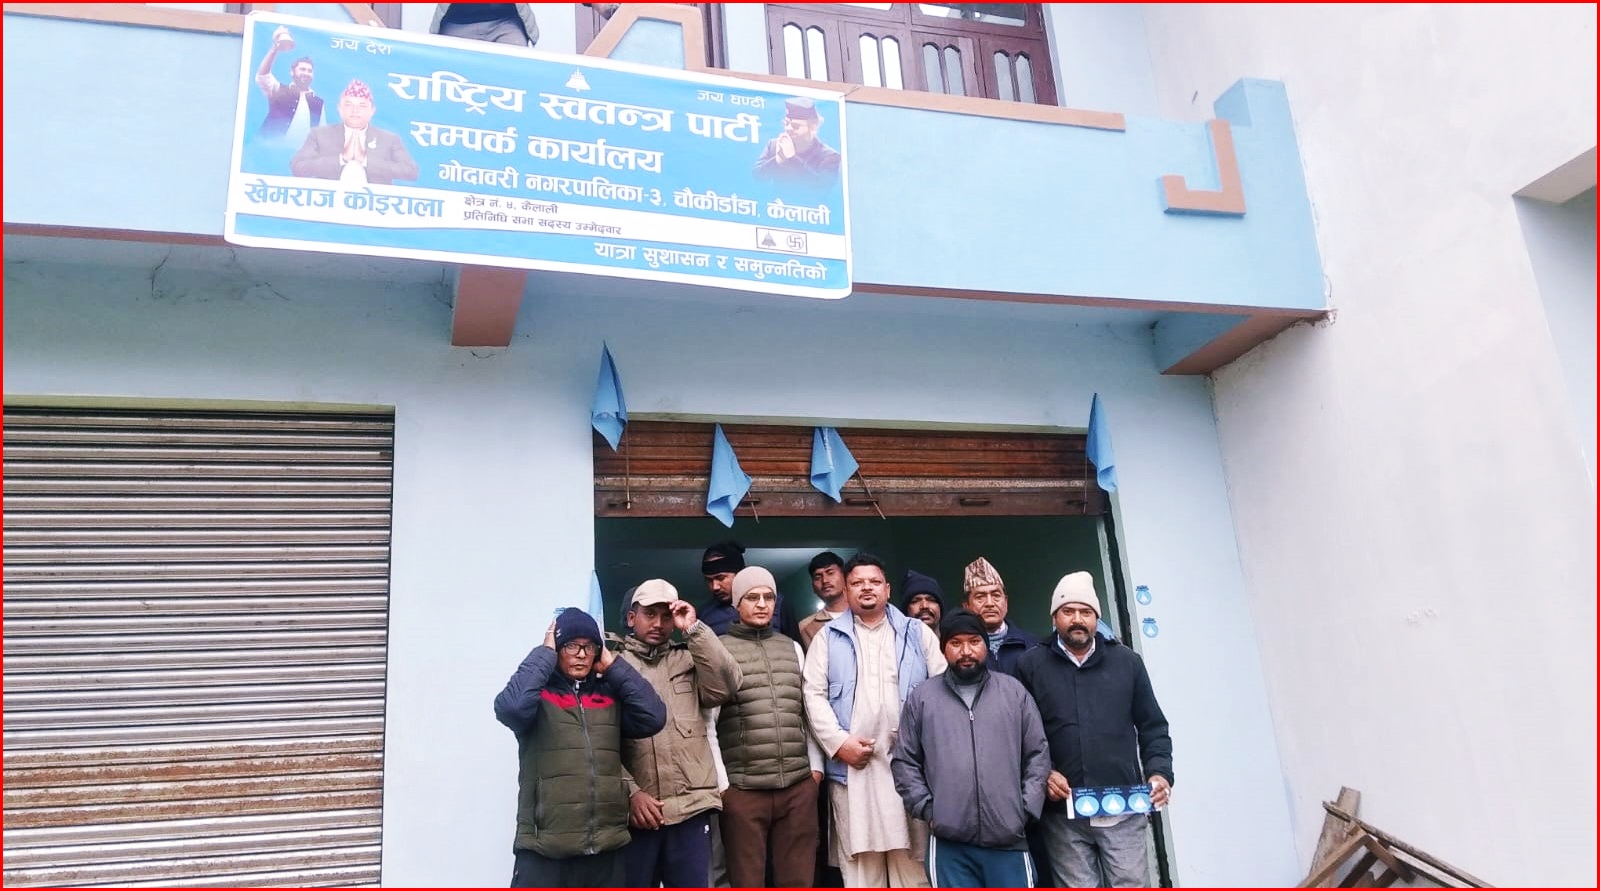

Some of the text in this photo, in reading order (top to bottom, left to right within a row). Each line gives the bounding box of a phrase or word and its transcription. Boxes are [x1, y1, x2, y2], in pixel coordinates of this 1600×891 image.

[330, 37, 392, 55] जय देश
[387, 70, 762, 144] राष्ट्रिय स्वतन्त्र पार्टी
[696, 89, 766, 110] जय घण्टी
[409, 120, 665, 174] सम्पर्क कार्यालय
[244, 178, 445, 217] खेमराज कोइराला
[438, 159, 520, 189] गोदावरी
[766, 197, 831, 226] कैलाली
[464, 194, 485, 207] क्षेत्र
[521, 200, 559, 214] कैलाली
[463, 209, 622, 235] प्रतिनिधि सभा सदस्य उम्मेदवार
[593, 242, 828, 281] यात्रा सुशासन र समुन्नतिको
